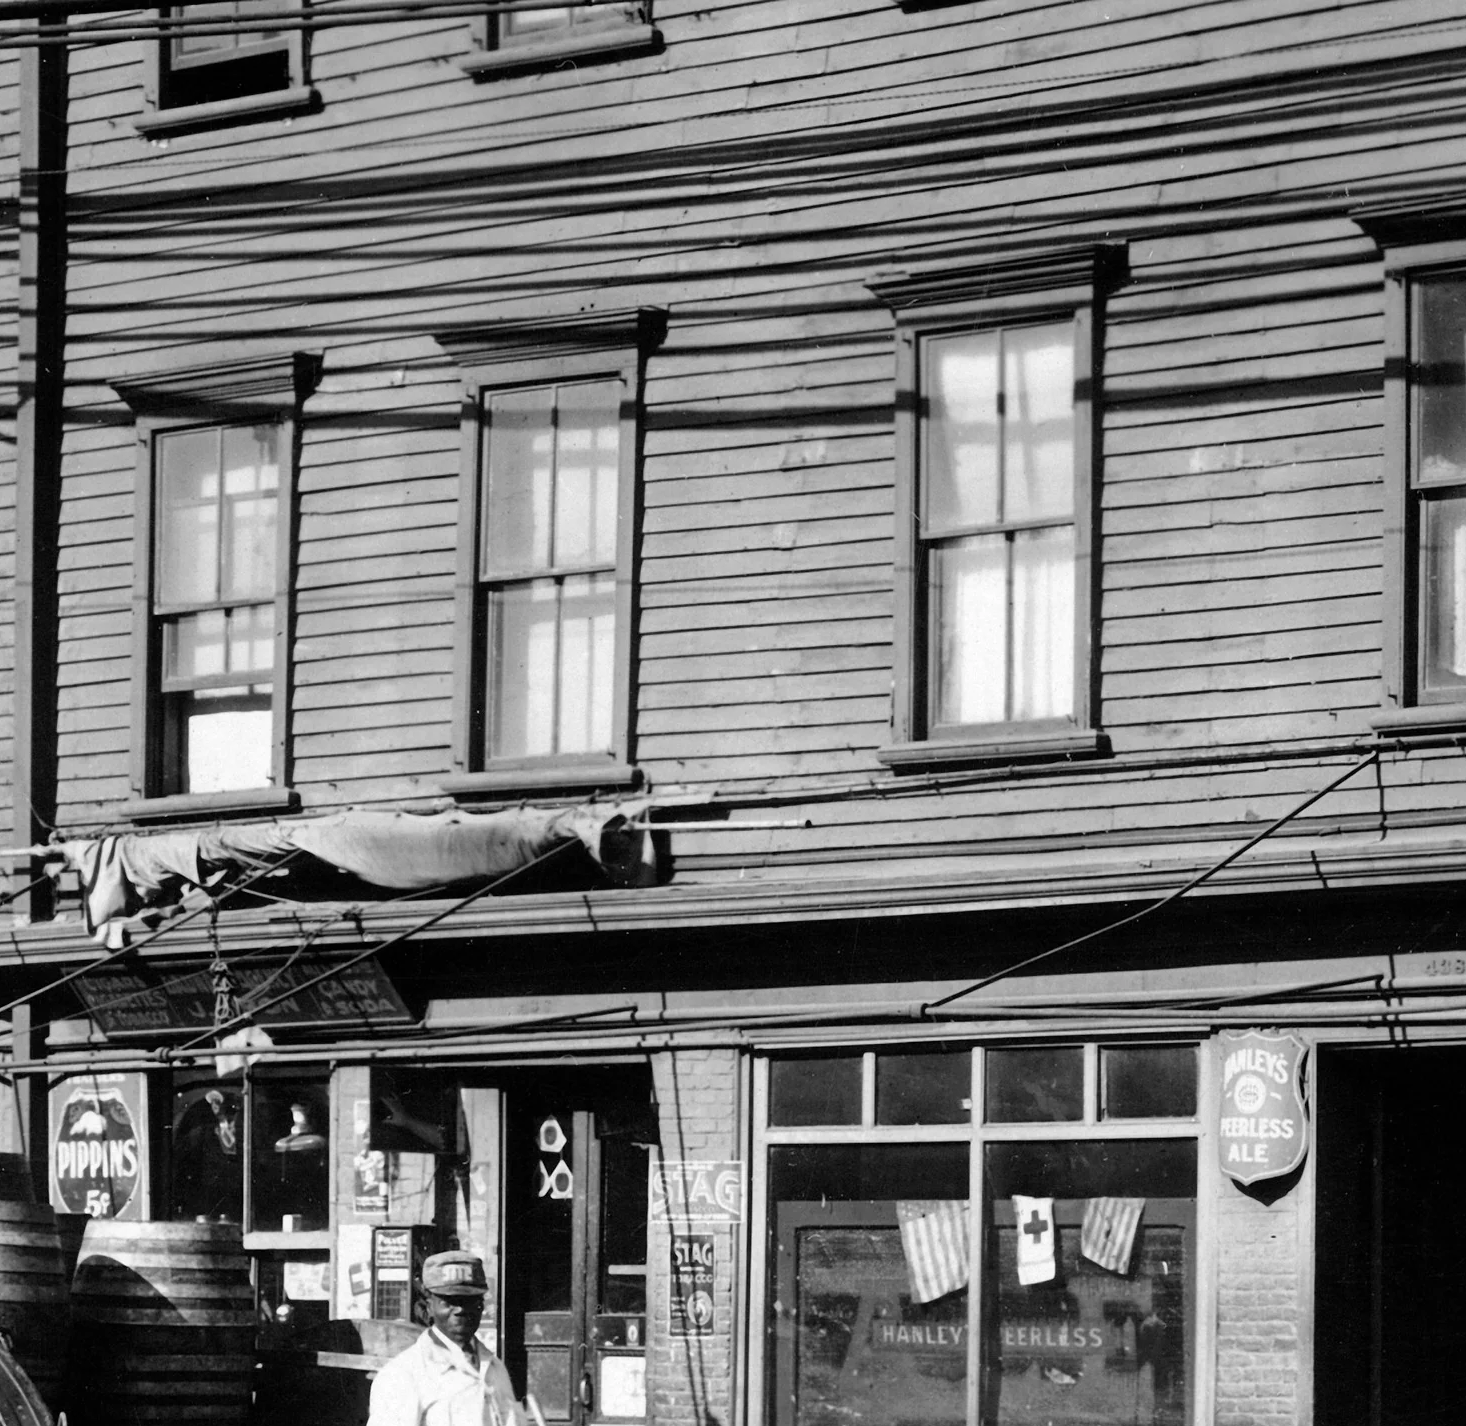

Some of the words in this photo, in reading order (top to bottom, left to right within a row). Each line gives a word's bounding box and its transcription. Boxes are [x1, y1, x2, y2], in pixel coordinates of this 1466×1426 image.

[318, 980, 379, 998] CANDY
[336, 998, 397, 1015] SODA
[1220, 1117, 1294, 1139] PEERLESS
[58, 1138, 138, 1179] PIPPINS
[1228, 1143, 1269, 1163] ALE
[652, 1170, 740, 1216] STAG
[674, 1240, 713, 1267] STAG
[883, 1322, 970, 1346] HANLEY'
[1004, 1323, 1104, 1349] EERLESS
